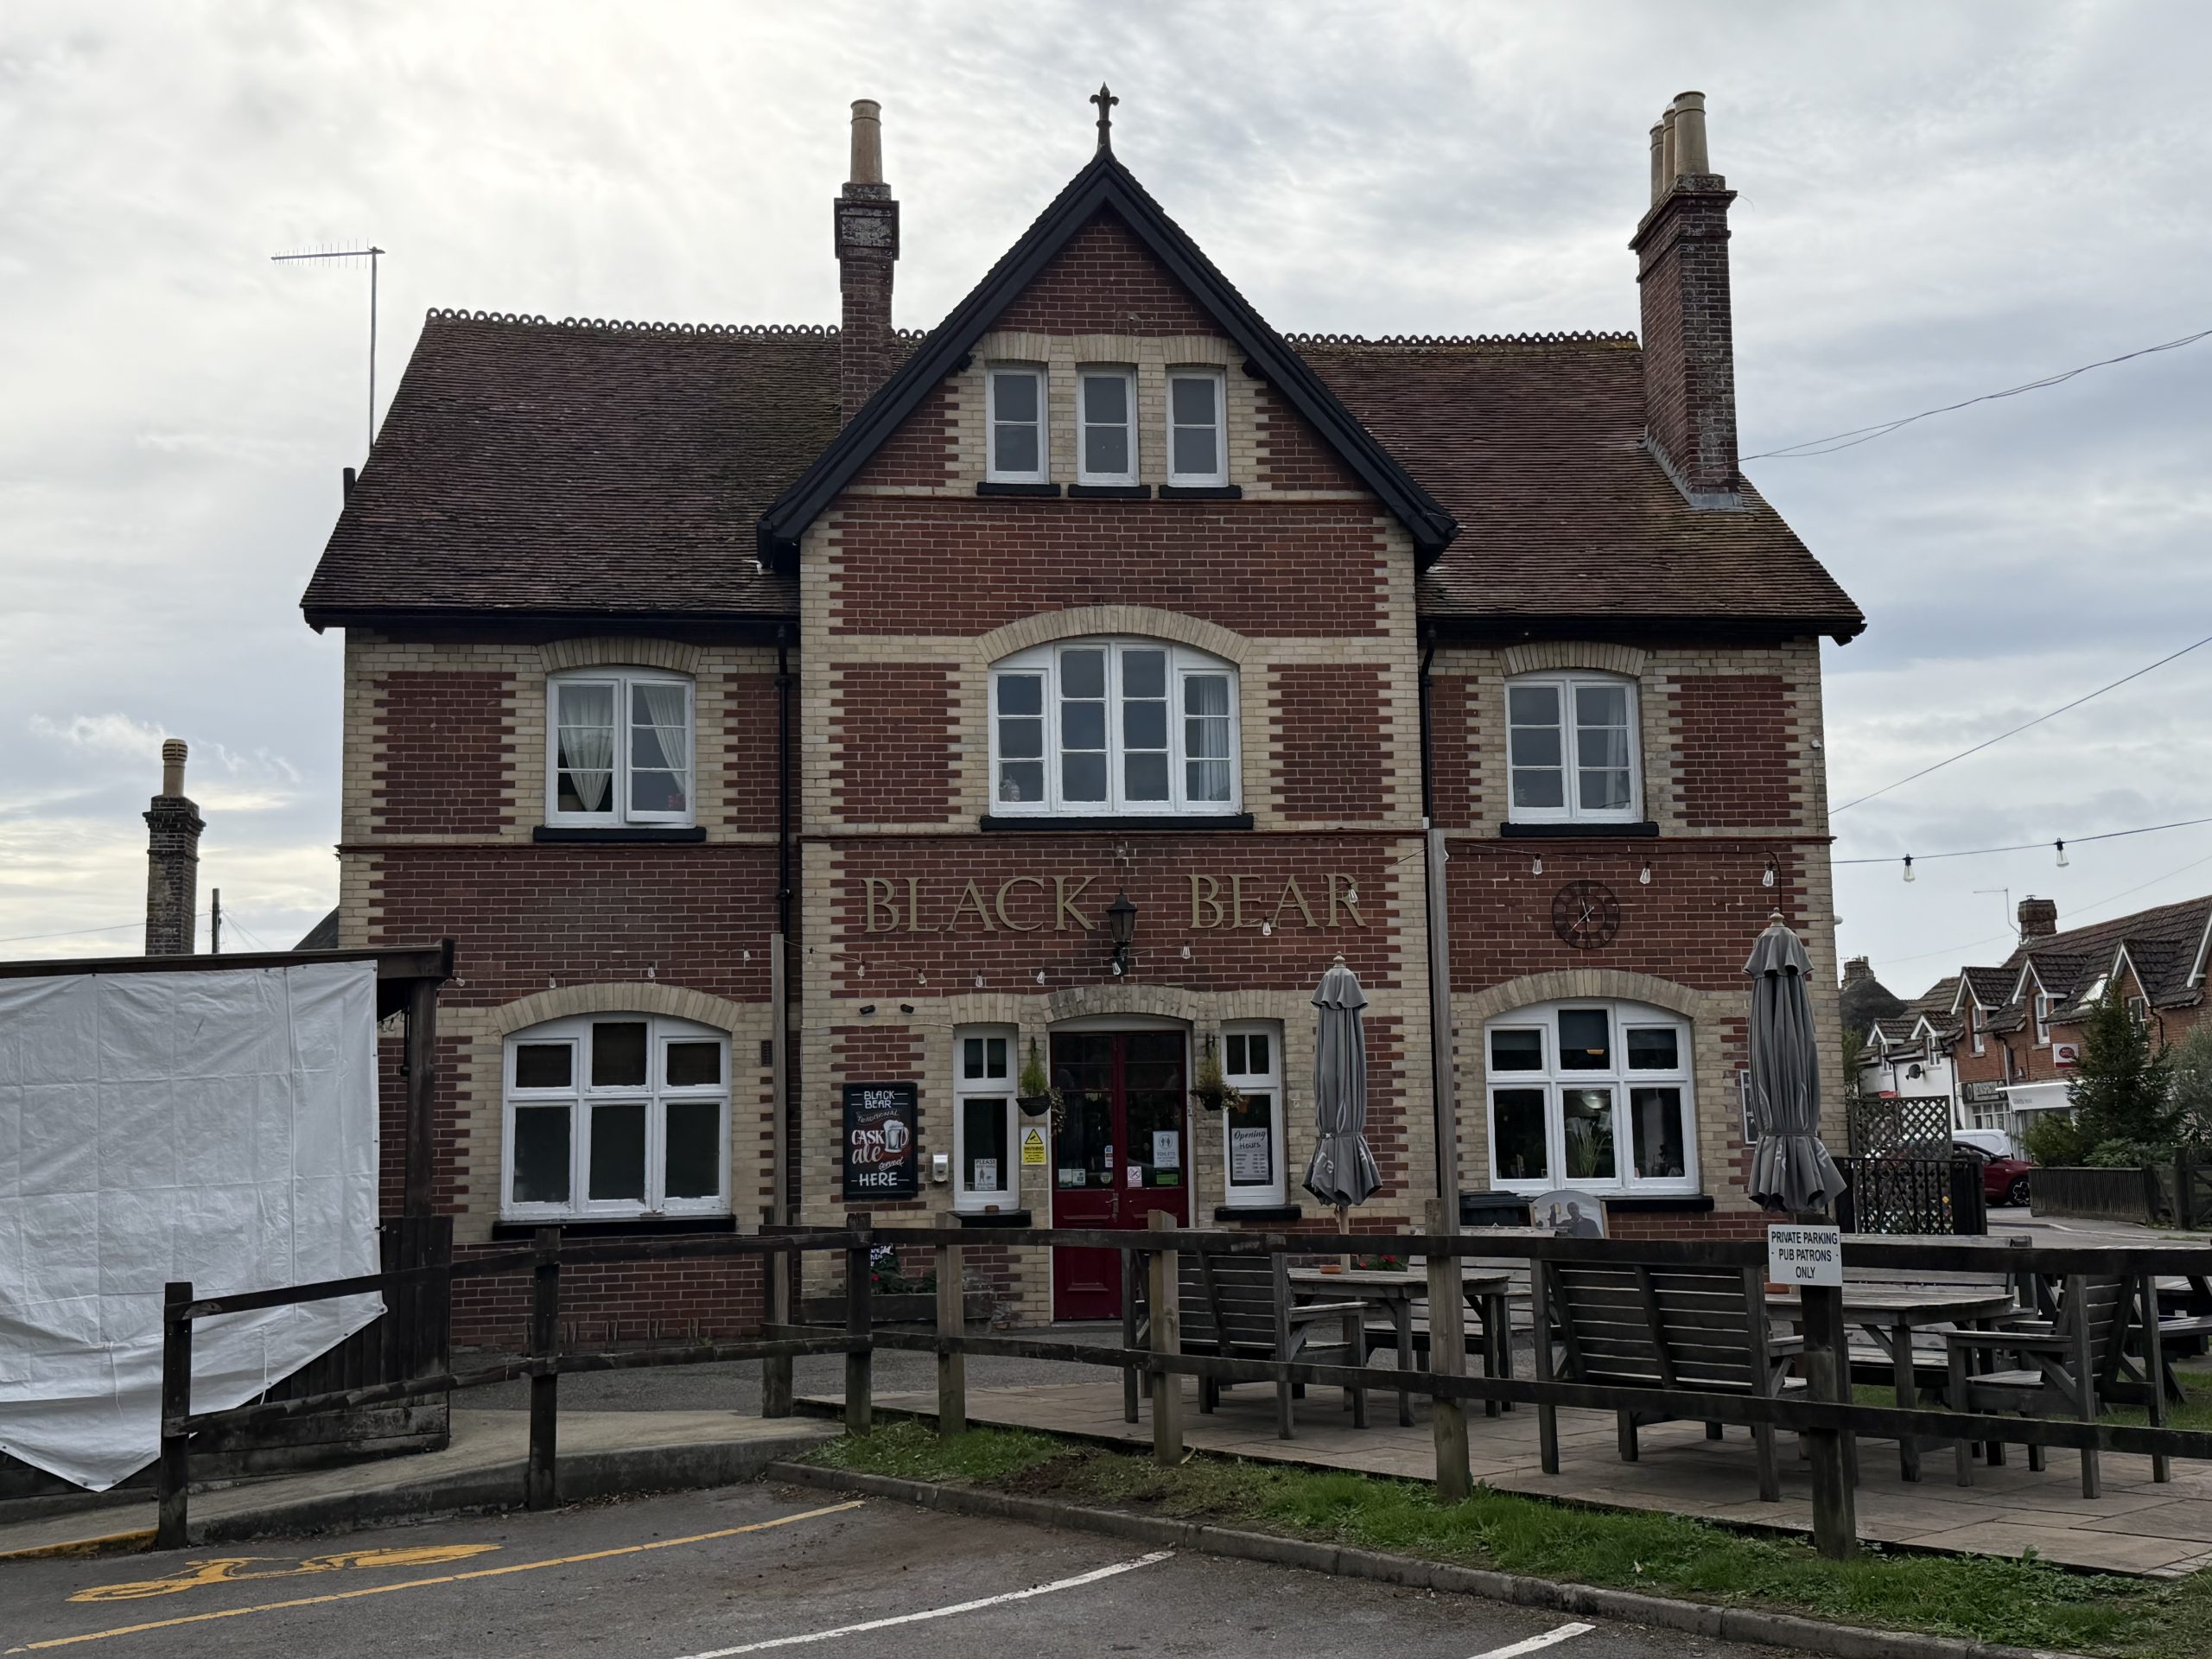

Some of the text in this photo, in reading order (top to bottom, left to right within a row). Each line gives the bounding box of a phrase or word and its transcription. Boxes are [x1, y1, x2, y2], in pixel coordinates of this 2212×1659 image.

[861, 873, 1368, 933] BLACK BEAR
[864, 1090, 895, 1100] BLACK
[865, 1099, 892, 1109] BEAR
[856, 1109, 899, 1123] TRADITIONAL
[851, 1129, 885, 1145] CASK
[1234, 1130, 1266, 1141] Opening
[852, 1144, 882, 1164] ale
[859, 1172, 898, 1186] HERE
[1771, 1231, 1838, 1244] PRIVATE PARKING
[1779, 1249, 1832, 1262] PUB PATRONS
[1796, 1266, 1815, 1279] ONLY
